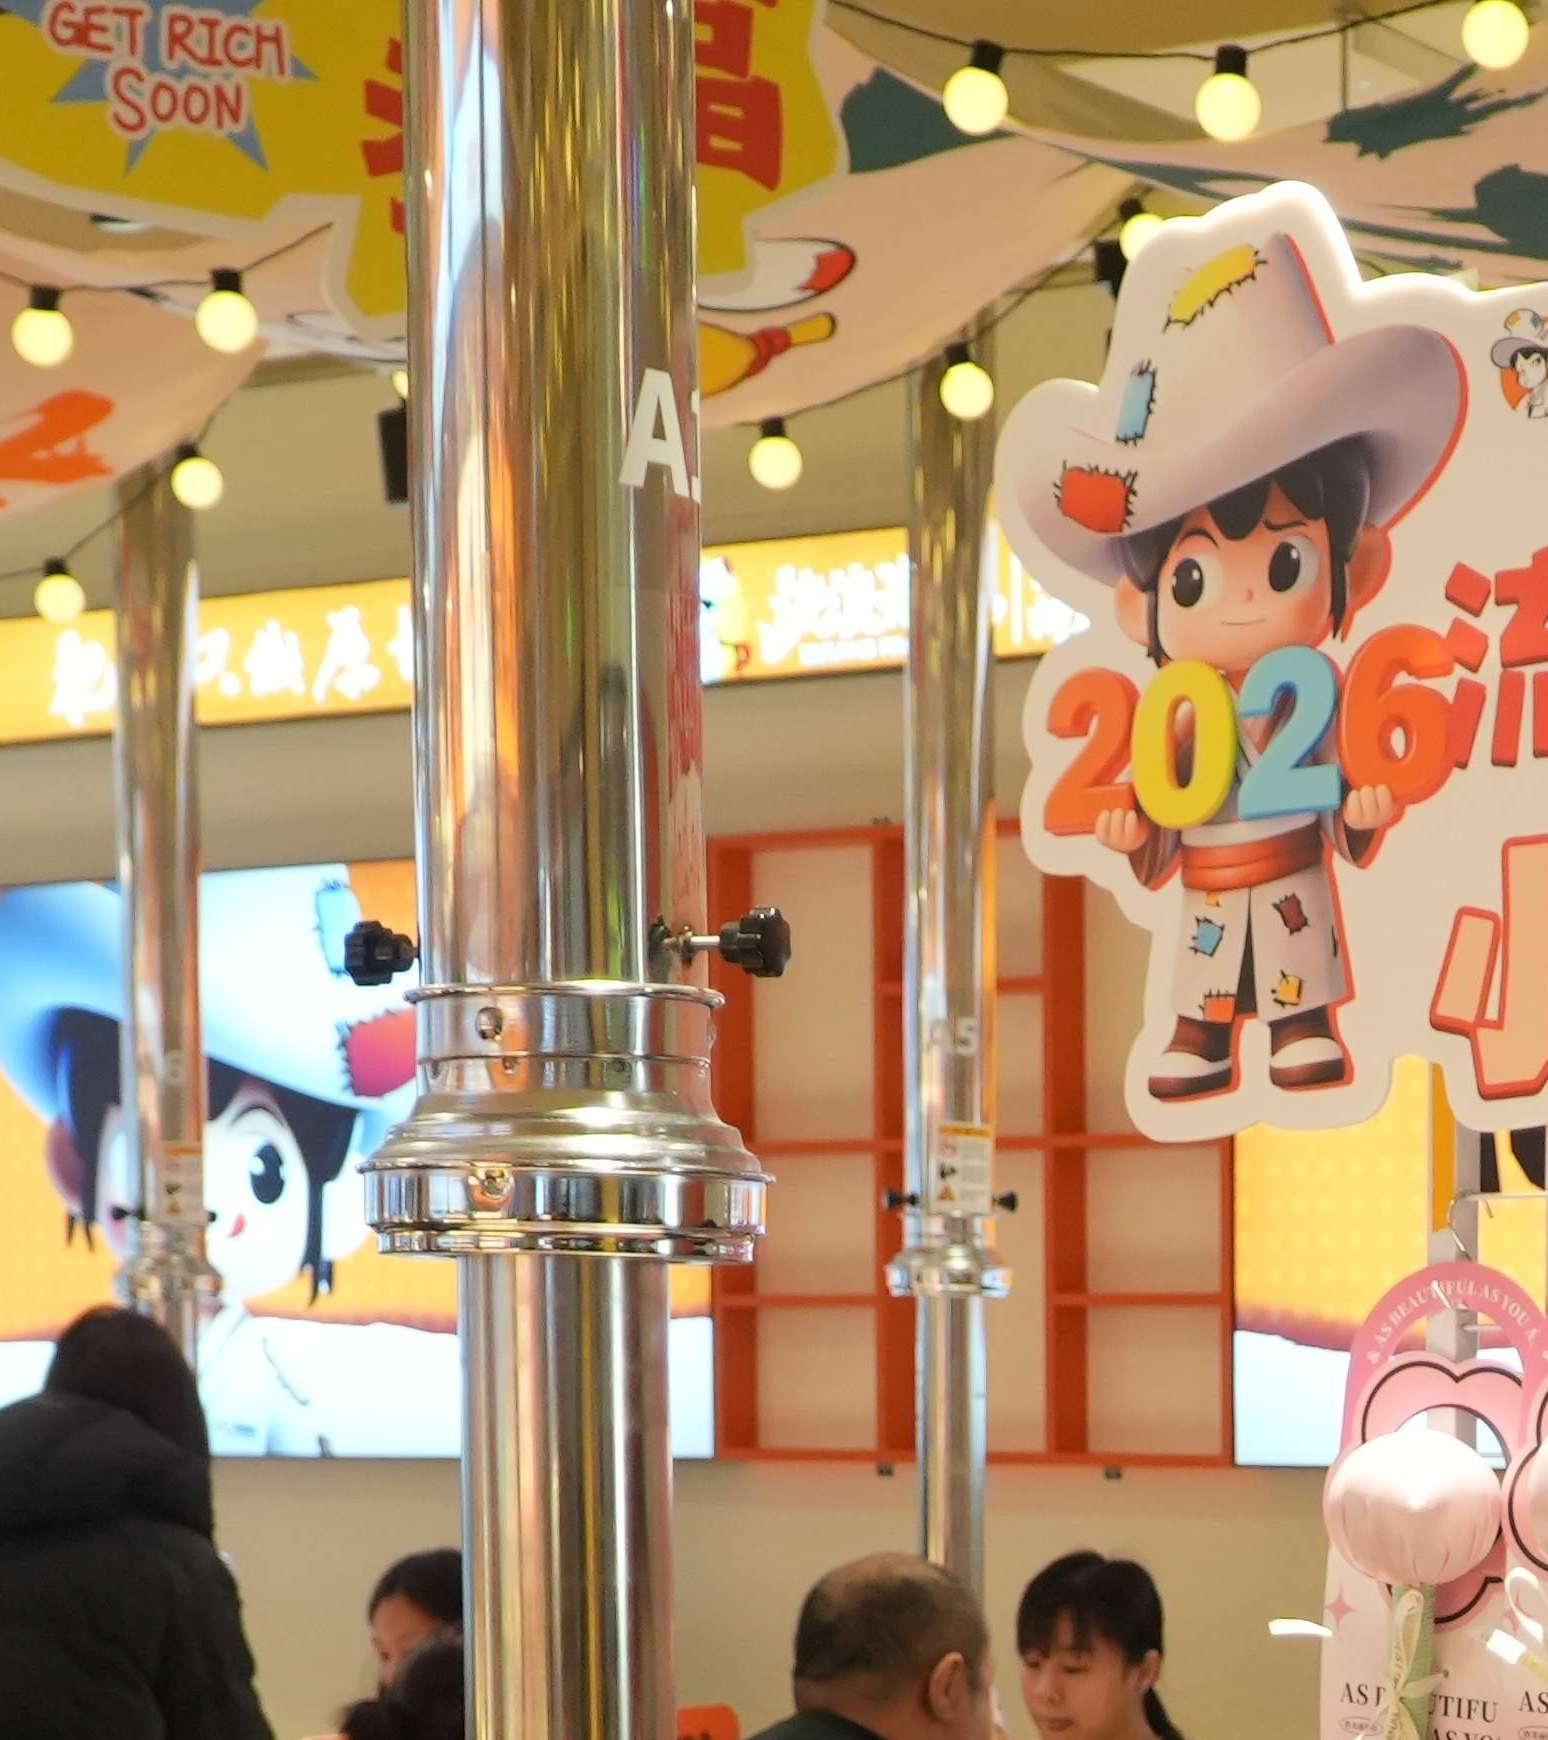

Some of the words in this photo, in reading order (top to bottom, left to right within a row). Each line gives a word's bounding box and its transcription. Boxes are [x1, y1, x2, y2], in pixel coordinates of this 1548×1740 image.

[49, 2, 143, 55] GET
[168, 14, 290, 78] RICH
[111, 69, 244, 136] SOON
[618, 366, 700, 505] A
[1043, 623, 1455, 837] 2026
[1374, 1325, 1395, 1346] AS
[1479, 1280, 1501, 1301] AS
[1501, 1290, 1531, 1328] YOU
[1339, 1681, 1370, 1707] AS
